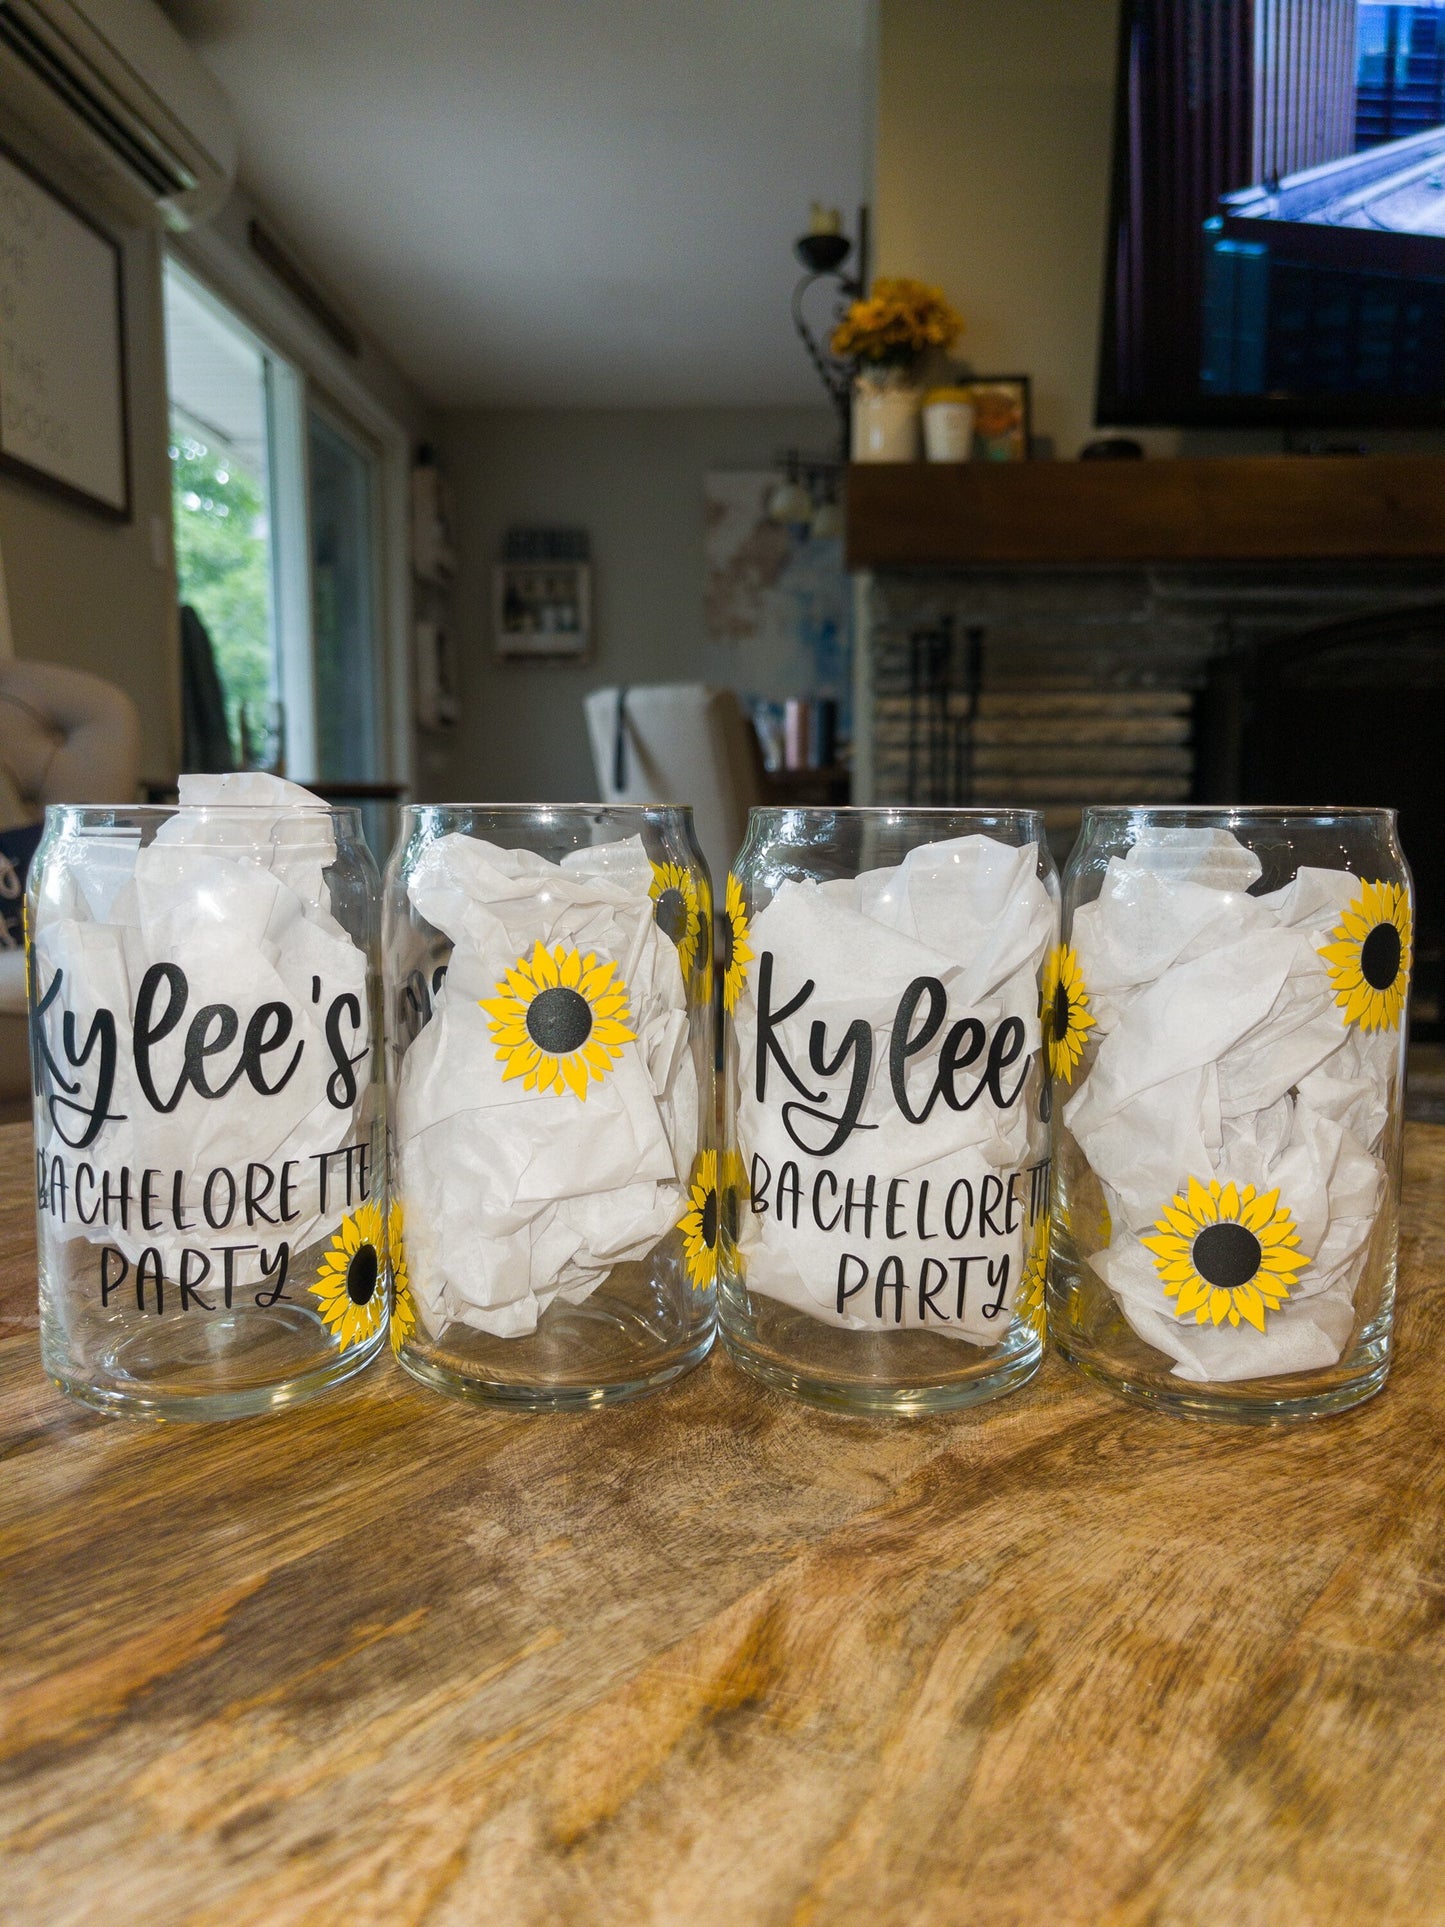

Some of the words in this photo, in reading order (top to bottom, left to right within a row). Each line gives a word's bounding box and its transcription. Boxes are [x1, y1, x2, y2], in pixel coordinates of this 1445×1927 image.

[29, 942, 370, 1149] Kylee's
[37, 1142, 371, 1231] BACHELORETTE
[101, 1241, 292, 1315] PARTY
[836, 1252, 1009, 1324] PARTY
